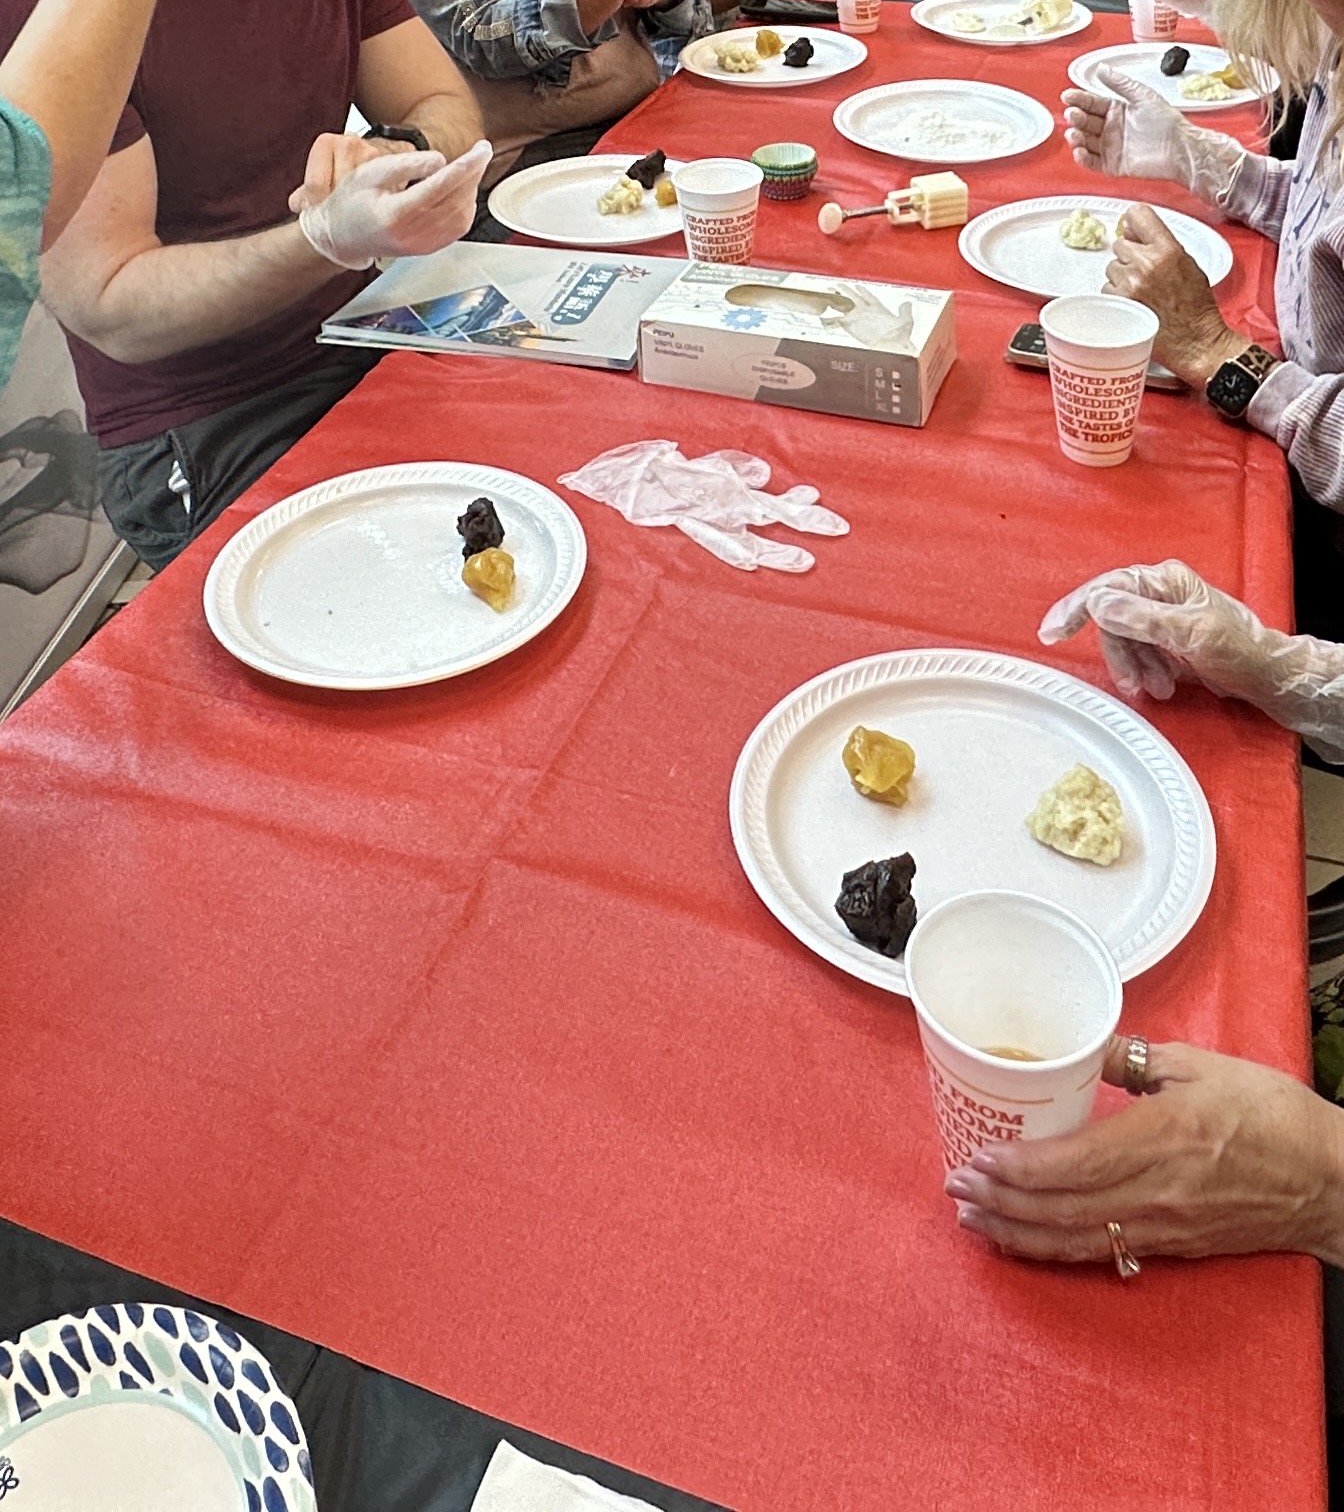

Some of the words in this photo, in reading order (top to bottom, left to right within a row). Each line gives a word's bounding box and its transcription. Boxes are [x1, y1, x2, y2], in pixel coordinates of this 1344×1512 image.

[686, 214, 734, 226] CRAFTED
[831, 360, 857, 372] SIZE
[1051, 361, 1106, 386] CRAFTED
[1110, 368, 1144, 387] FROM
[1053, 374, 1142, 398] WHOLESOME
[1054, 385, 1140, 409] INGREDIENTS
[1056, 396, 1119, 422] INSPIRED
[1122, 404, 1138, 419] BY
[1059, 420, 1080, 439] THE
[1083, 427, 1133, 444] TROPICS
[1076, 418, 1123, 432] TASTES
[949, 1082, 1025, 1127] FROM
